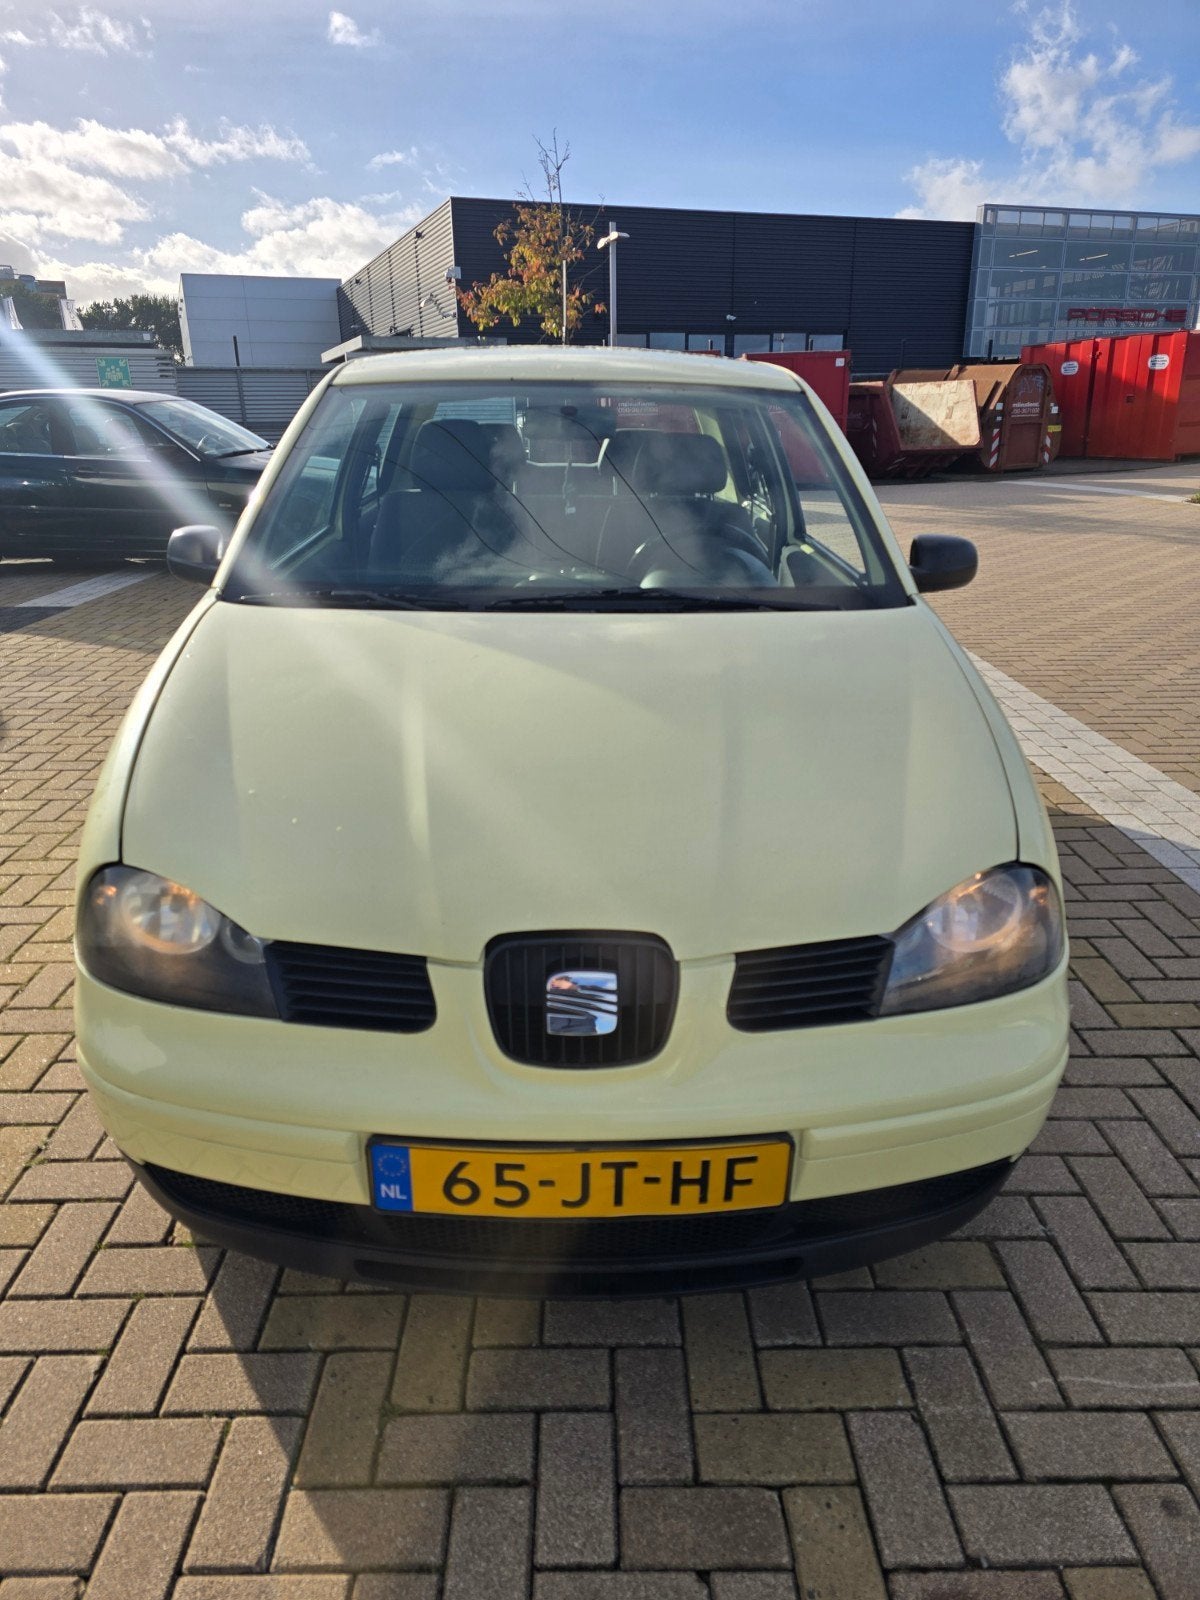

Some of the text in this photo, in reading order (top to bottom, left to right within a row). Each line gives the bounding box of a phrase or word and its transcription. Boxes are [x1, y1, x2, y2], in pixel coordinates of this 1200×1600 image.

[1068, 308, 1187, 322] PORSCHE
[443, 1156, 758, 1208] 65-JT-HF
[381, 1184, 407, 1199] NL
